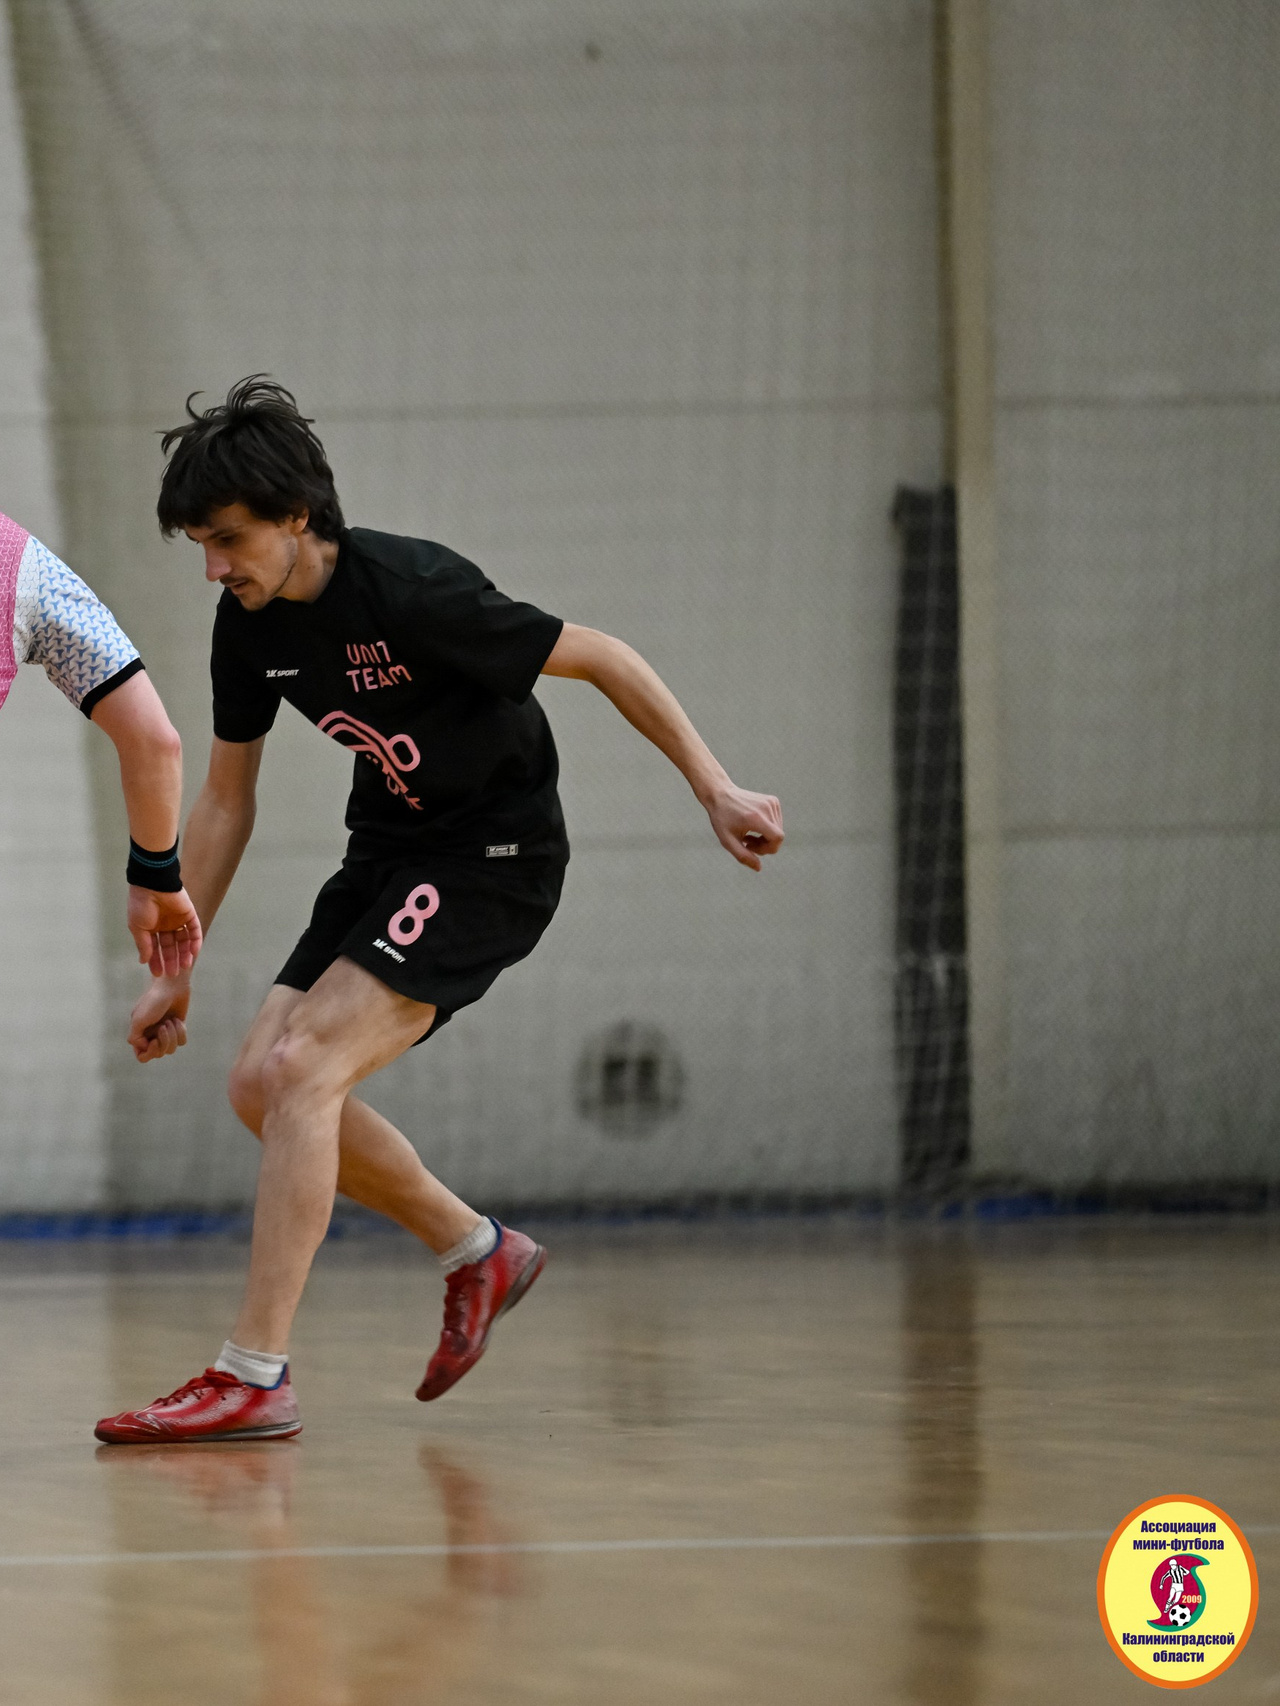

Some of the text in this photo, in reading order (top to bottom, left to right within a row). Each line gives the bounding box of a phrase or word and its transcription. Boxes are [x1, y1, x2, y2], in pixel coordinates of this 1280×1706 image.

[346, 640, 392, 665] UNIT
[277, 668, 299, 677] SPORT
[346, 665, 412, 693] TEAM
[387, 883, 440, 946] 8
[383, 946, 406, 963] SPORT
